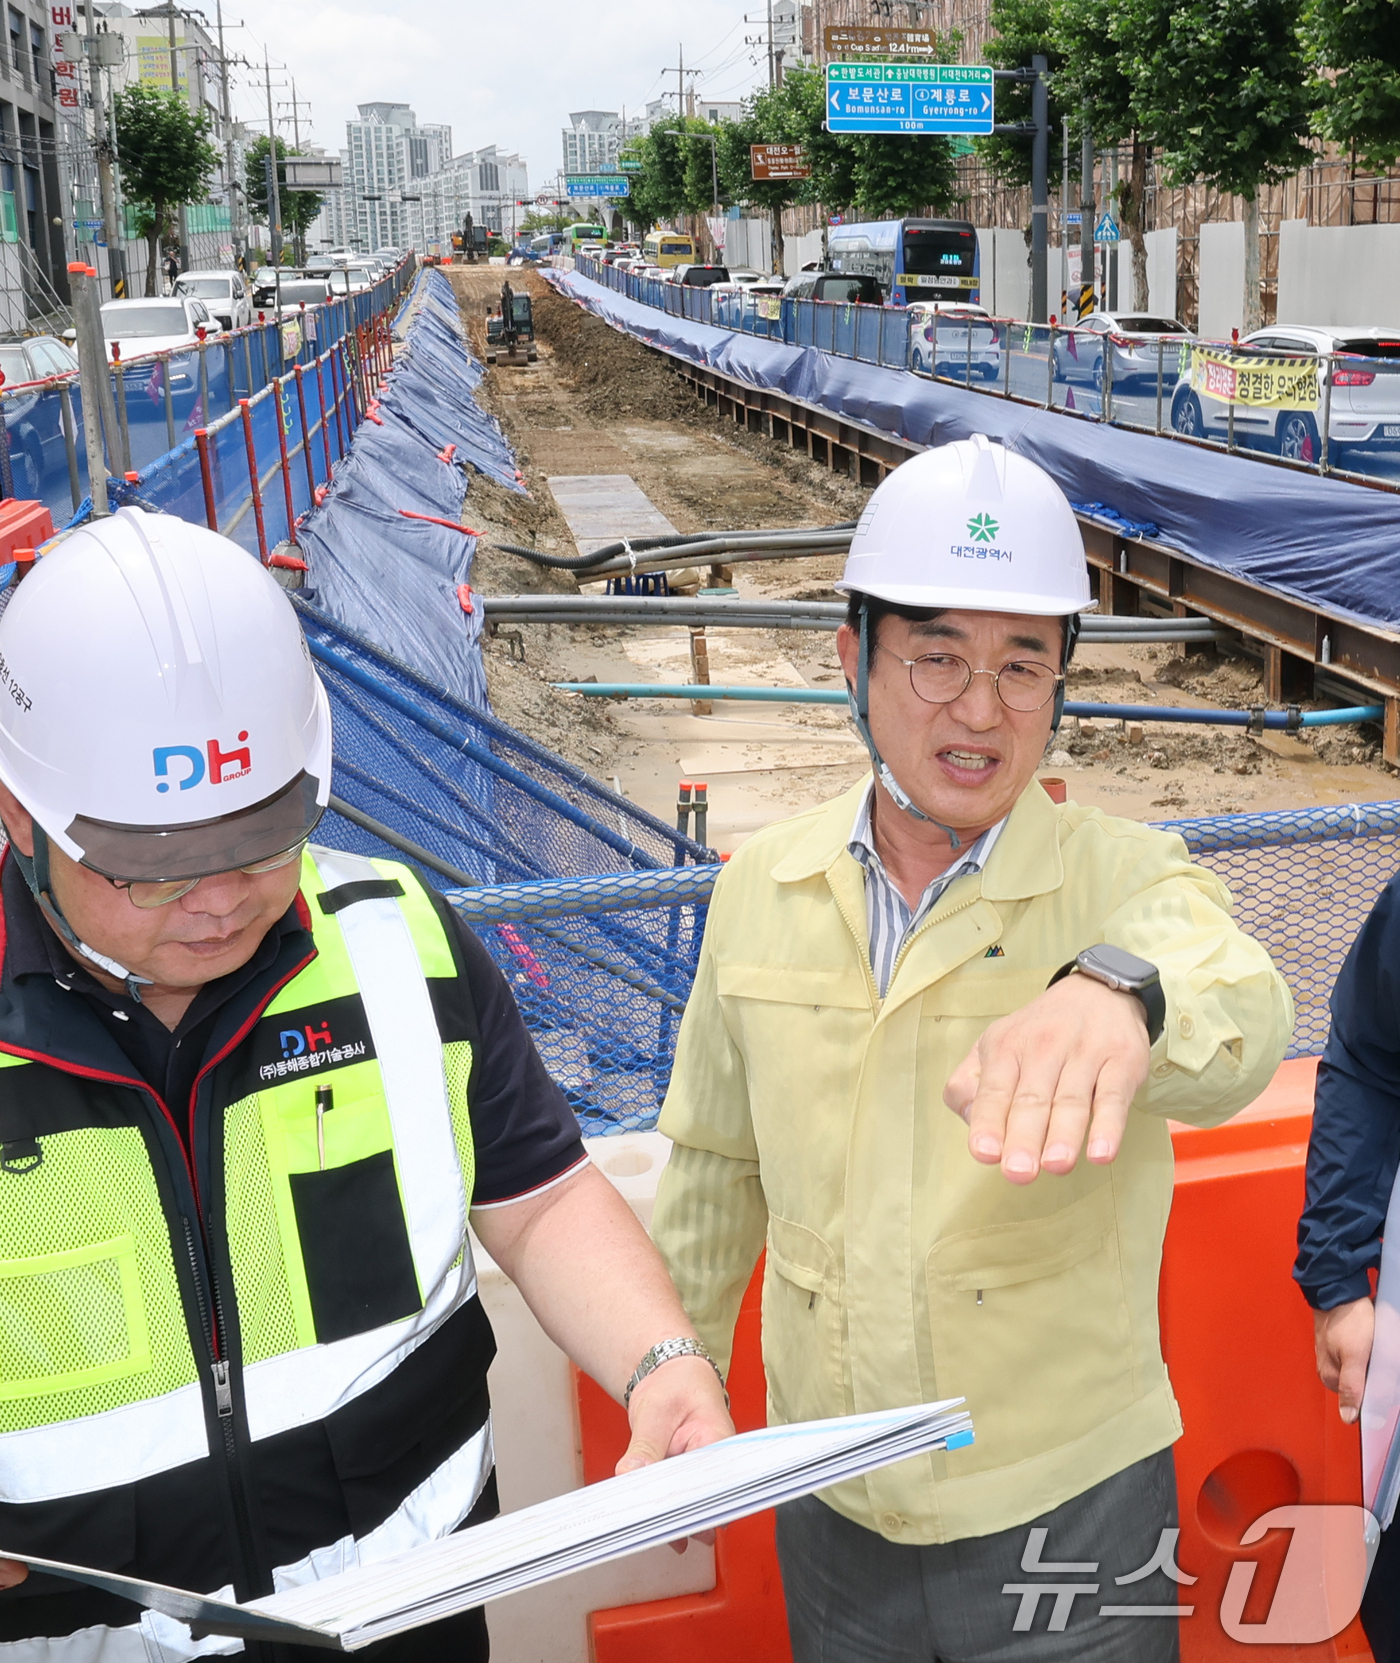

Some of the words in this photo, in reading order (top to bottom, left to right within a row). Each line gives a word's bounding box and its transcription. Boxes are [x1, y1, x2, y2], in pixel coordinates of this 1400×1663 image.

[850, 44, 864, 52] Cup
[51, 6, 78, 107] 버학원
[841, 67, 881, 80] 한밭도서관
[895, 68, 936, 81] 충남대학병원
[942, 69, 981, 81] 서대전네거리
[847, 87, 903, 103] 보문산로
[930, 88, 971, 106] 계룡로
[845, 104, 906, 115] Bomunsan-ro
[923, 105, 978, 117] Gyeryong-ro
[899, 121, 924, 130] 100m
[1238, 372, 1274, 400] 청결한
[950, 545, 1012, 563] 대전광역시
[8, 678, 33, 713] 12공구
[223, 768, 252, 782] GROUP
[259, 1041, 366, 1080] (주)동해종합기술공사
